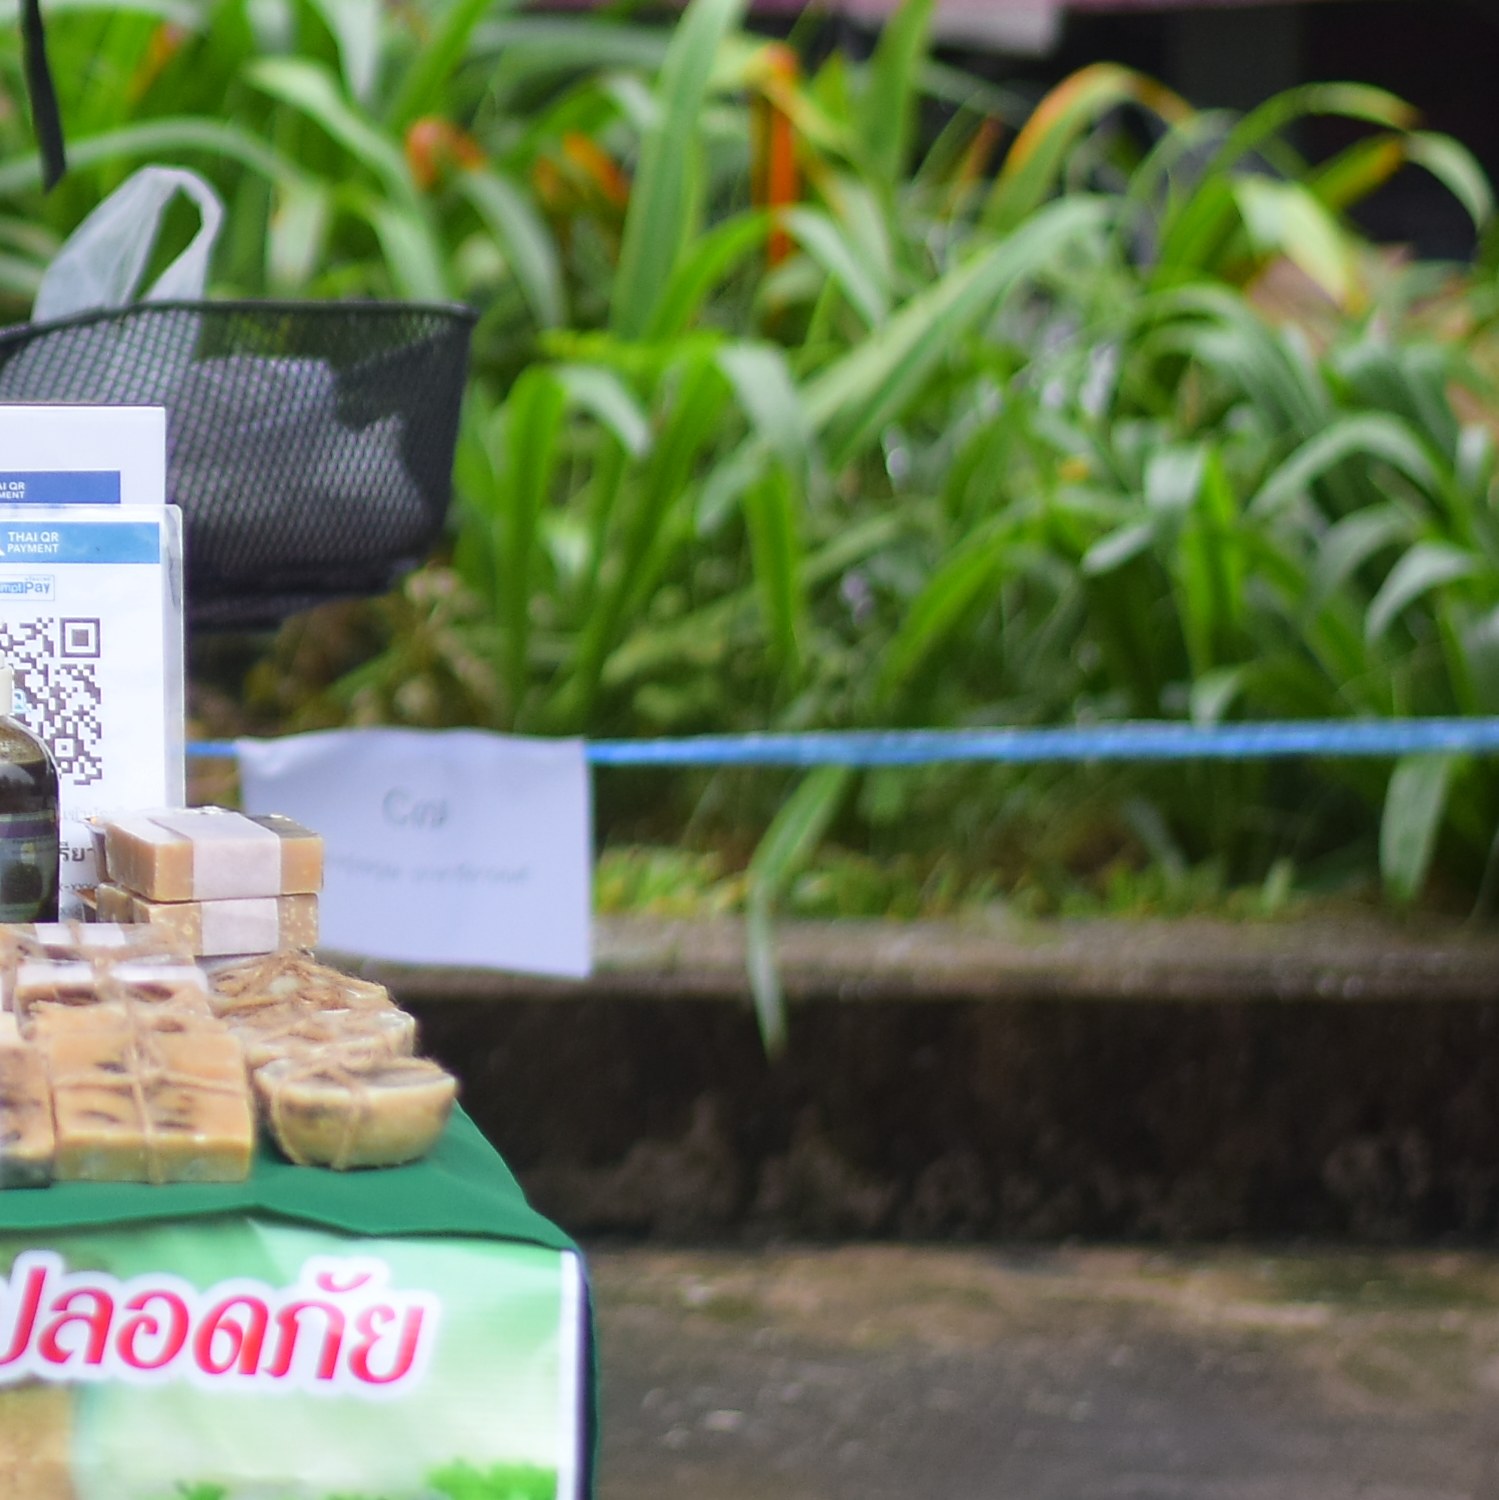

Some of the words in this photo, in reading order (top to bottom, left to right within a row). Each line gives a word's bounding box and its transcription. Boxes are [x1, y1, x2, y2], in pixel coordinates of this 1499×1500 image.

[9, 482, 25, 491] QR
[7, 531, 38, 543] THAI
[41, 531, 59, 543] QR
[7, 543, 59, 553] PAYMENT
